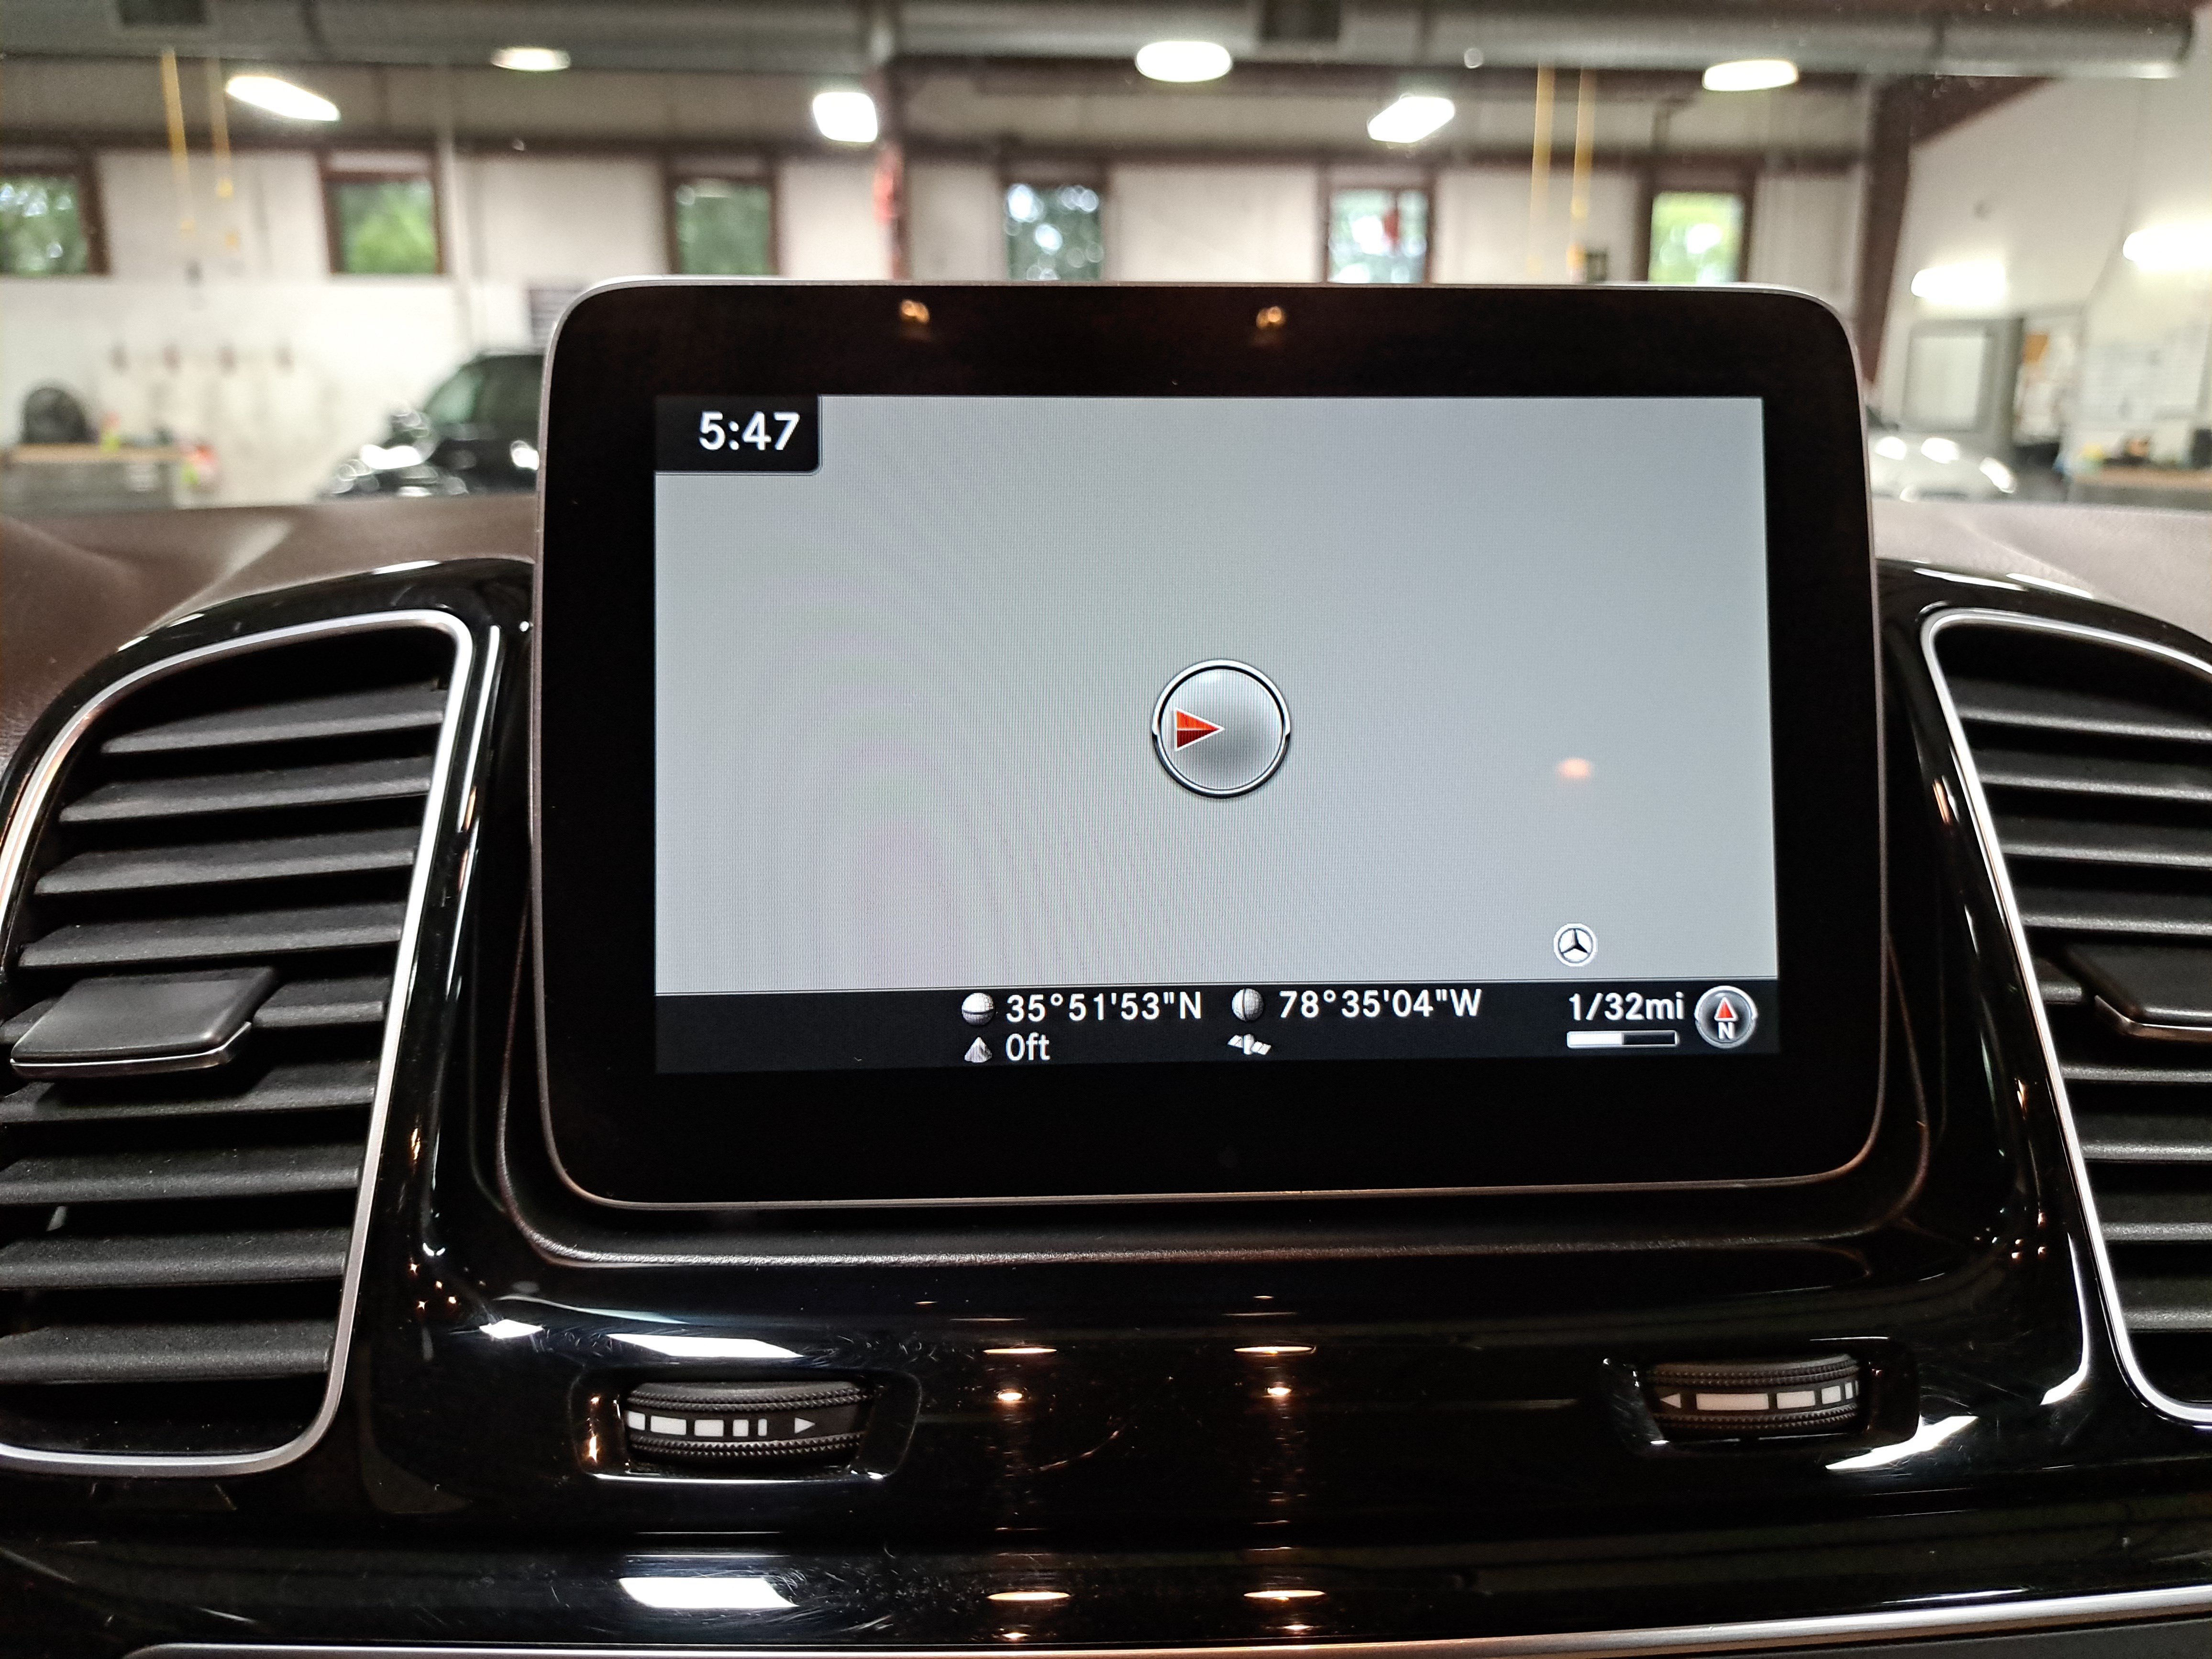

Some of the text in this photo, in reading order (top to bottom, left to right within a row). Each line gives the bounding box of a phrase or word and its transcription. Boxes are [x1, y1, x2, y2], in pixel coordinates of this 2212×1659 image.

[699, 411, 800, 450] 5:47
[1569, 992, 1684, 1021] 1/32mi
[1718, 1021, 1735, 1040] N
[1006, 1031, 1051, 1061] 0ft
